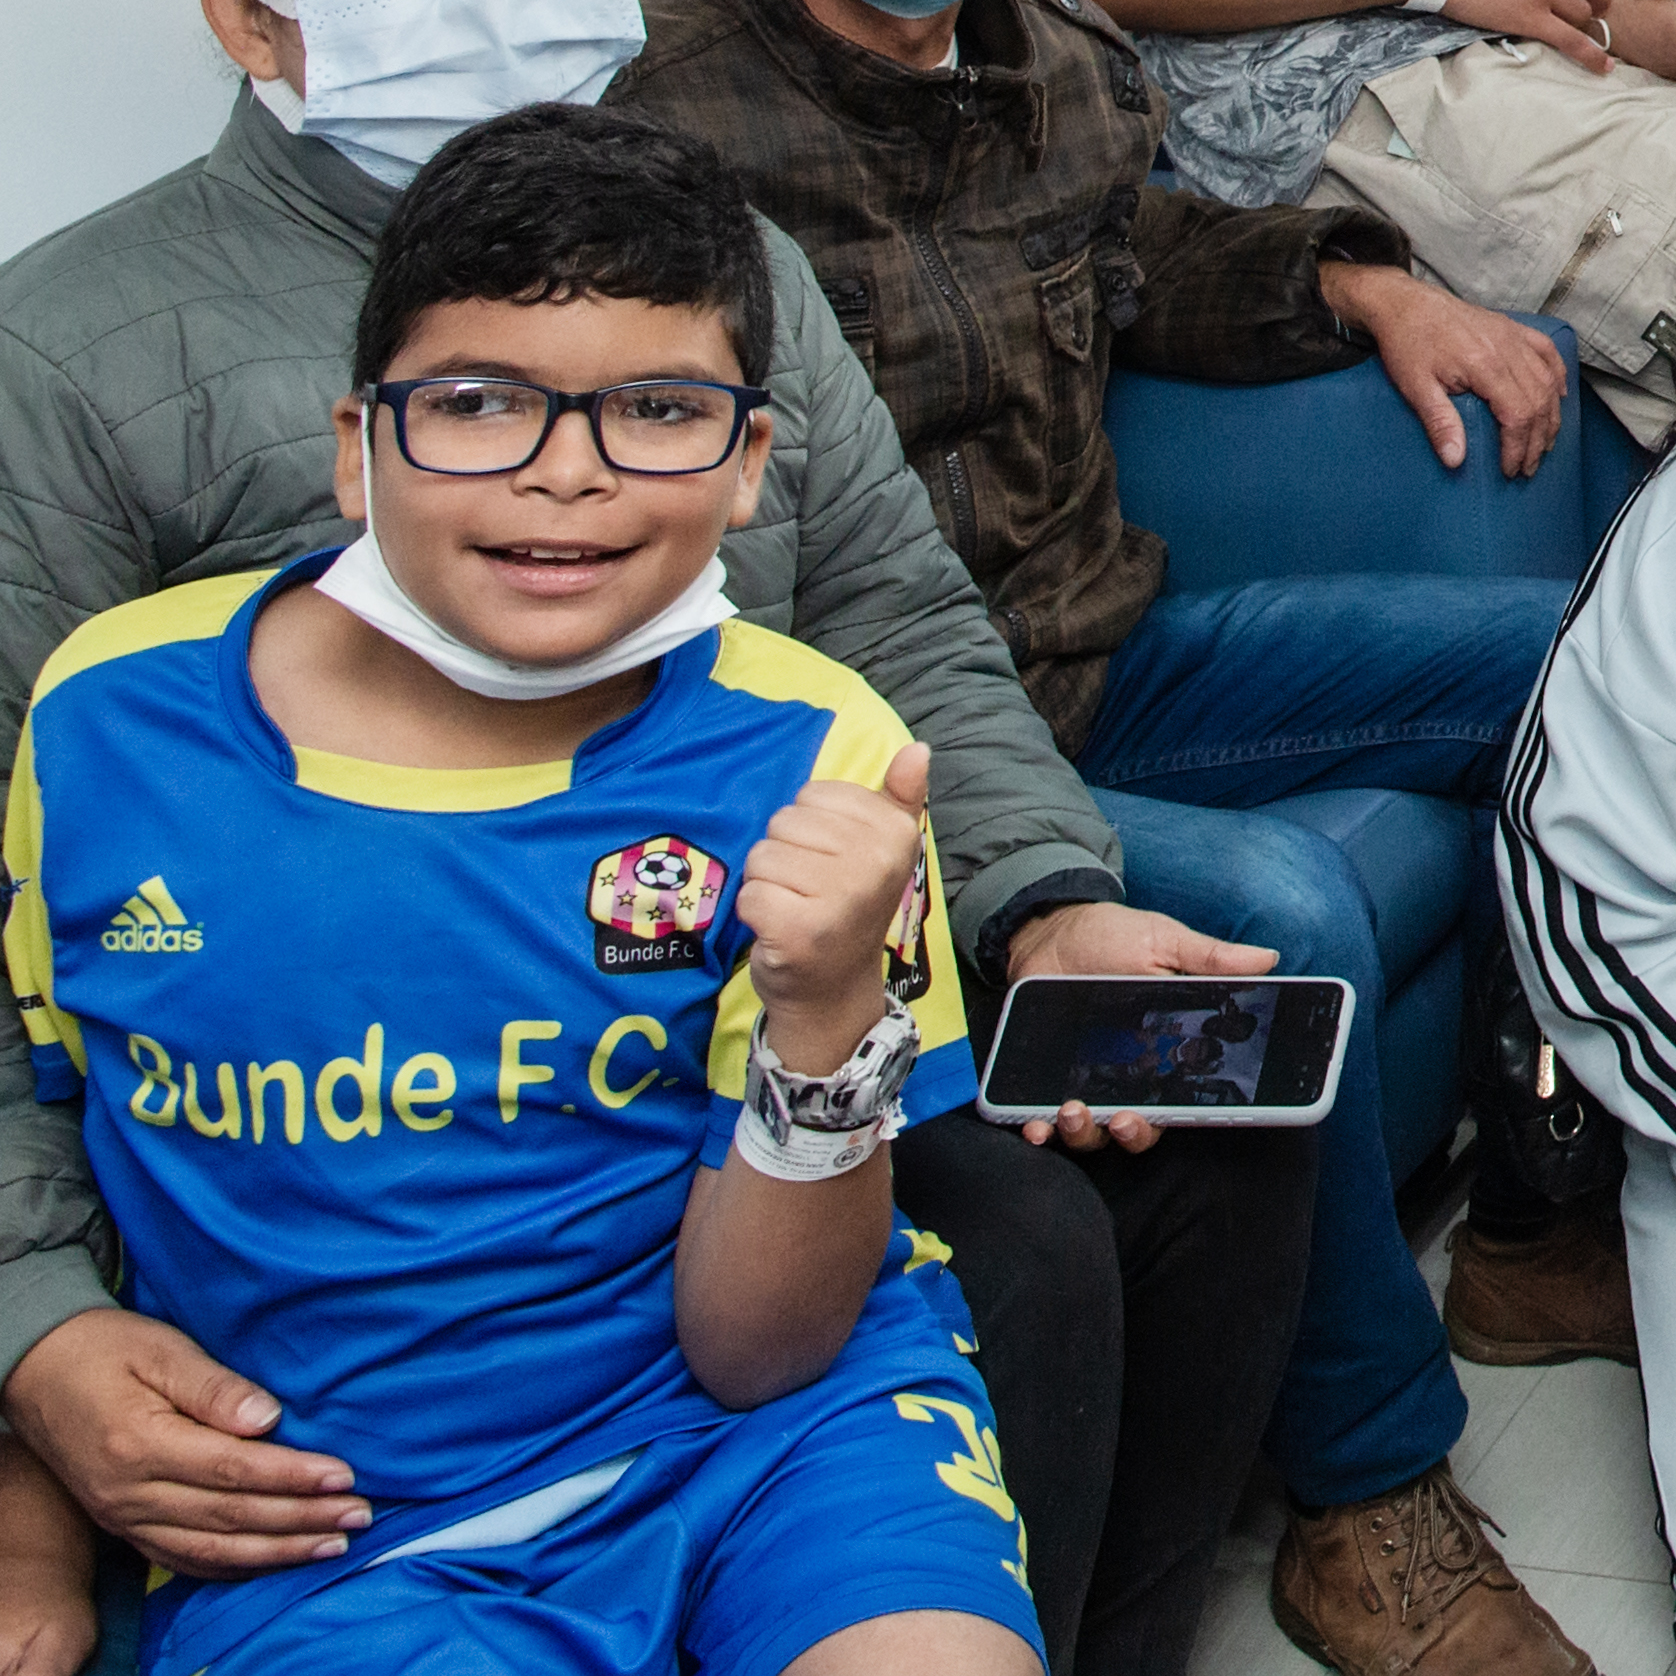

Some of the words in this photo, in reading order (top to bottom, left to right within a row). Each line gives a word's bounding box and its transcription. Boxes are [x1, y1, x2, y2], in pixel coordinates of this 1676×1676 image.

[101, 923, 204, 953] adidas
[604, 941, 663, 965] Bunde
[127, 1021, 458, 1145] Bunde
